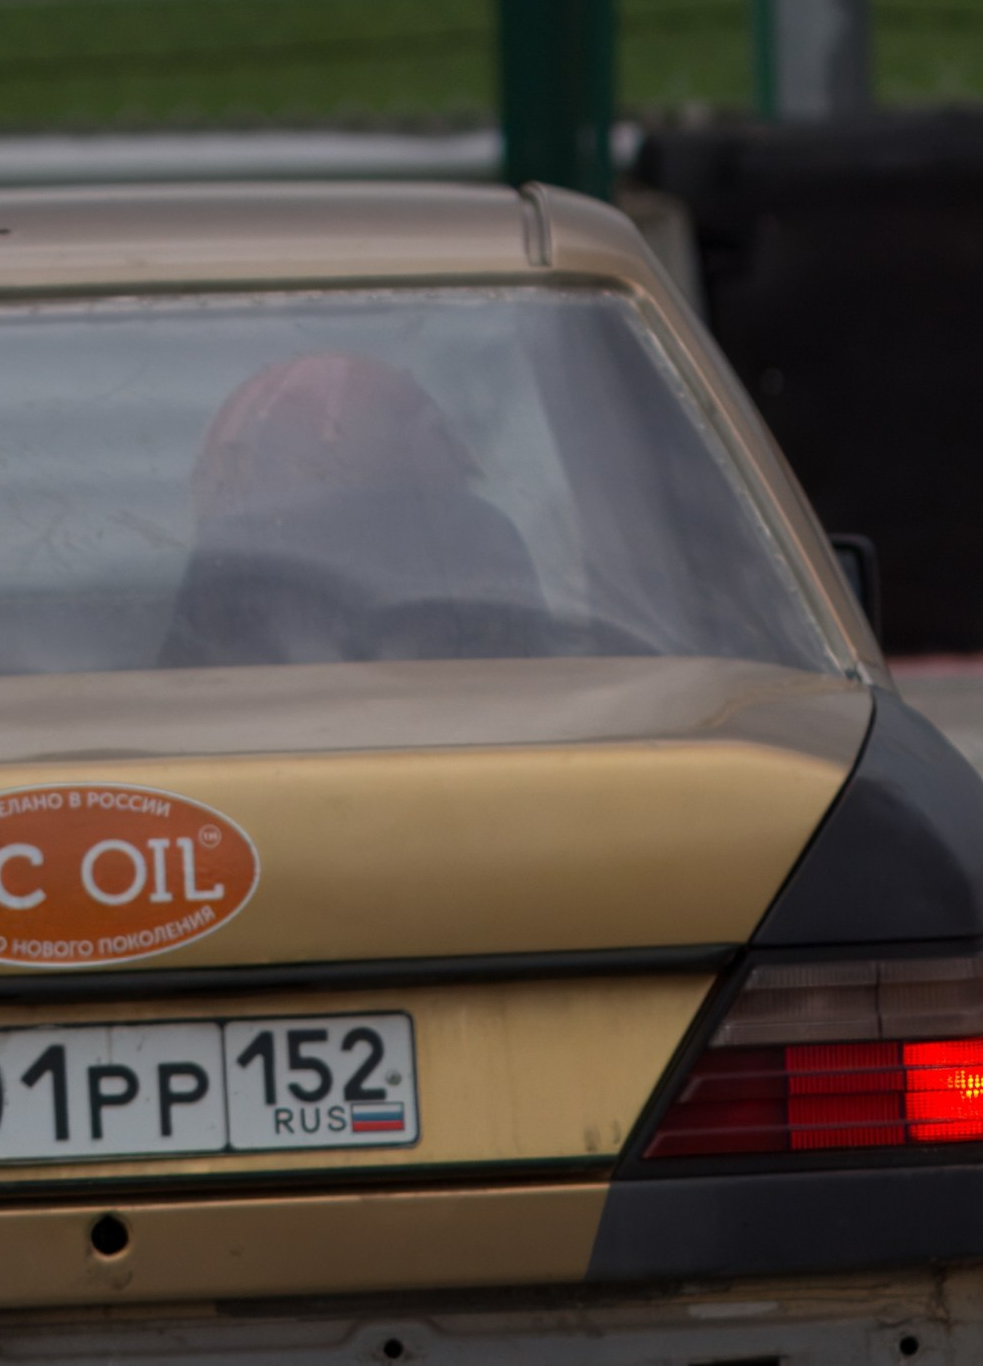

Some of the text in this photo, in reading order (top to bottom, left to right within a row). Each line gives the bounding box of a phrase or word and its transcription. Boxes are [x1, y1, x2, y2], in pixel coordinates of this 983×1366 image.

[68, 792, 81, 809] В
[87, 792, 171, 818] РОССИИ
[80, 838, 224, 906] OIL
[13, 938, 94, 958] НОВОГО
[99, 905, 216, 955] ПОКОЛЕНИЯ
[236, 1026, 387, 1106] 152
[275, 1105, 347, 1135] RUS
